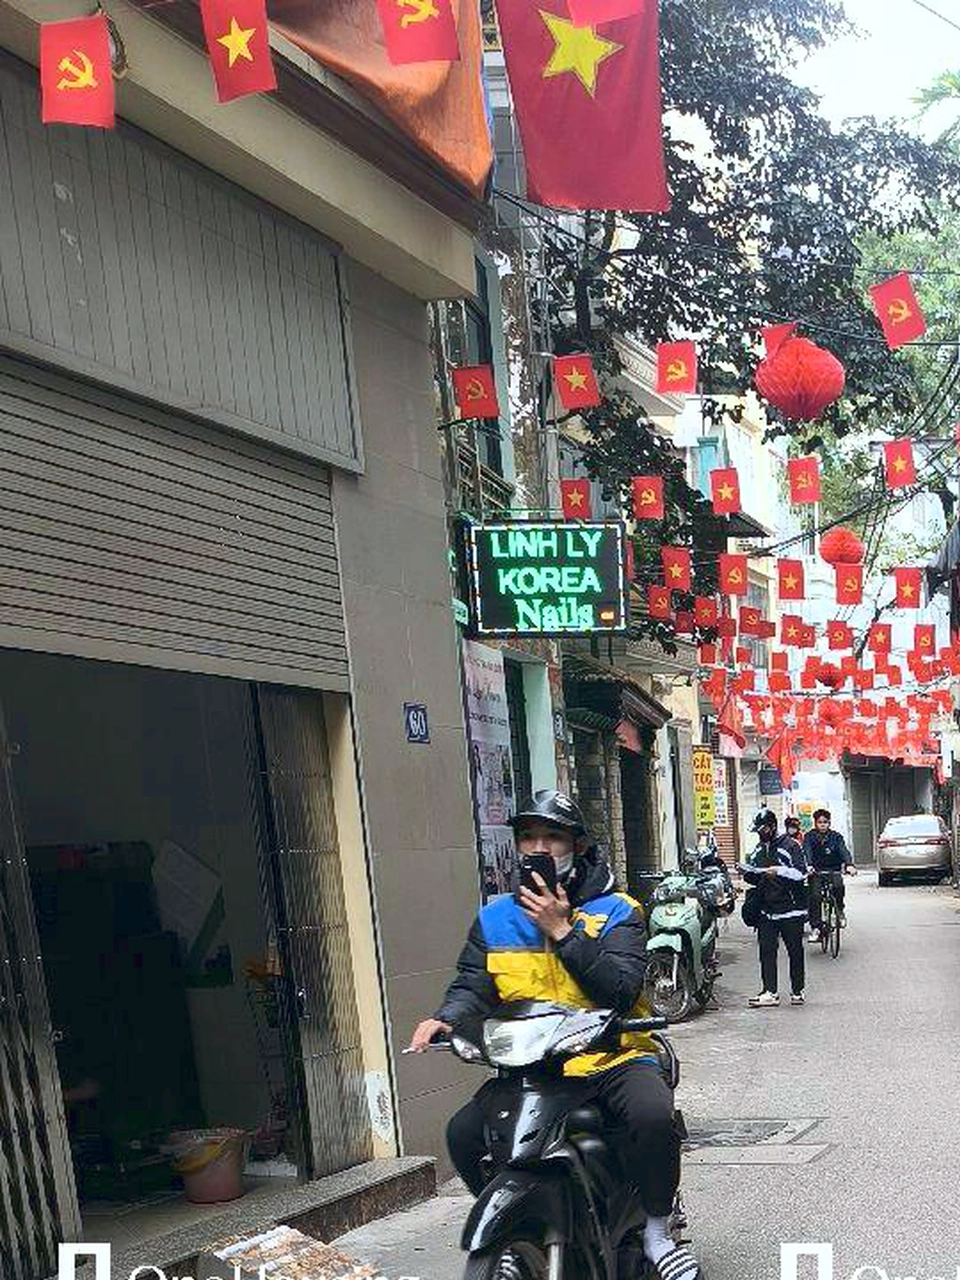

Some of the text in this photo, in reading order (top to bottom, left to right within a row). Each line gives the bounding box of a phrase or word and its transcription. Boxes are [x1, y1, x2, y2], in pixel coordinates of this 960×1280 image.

[490, 531, 602, 558] LINH LY
[497, 566, 602, 595] KOREA
[514, 597, 594, 629] Nails
[409, 710, 426, 735] 60
